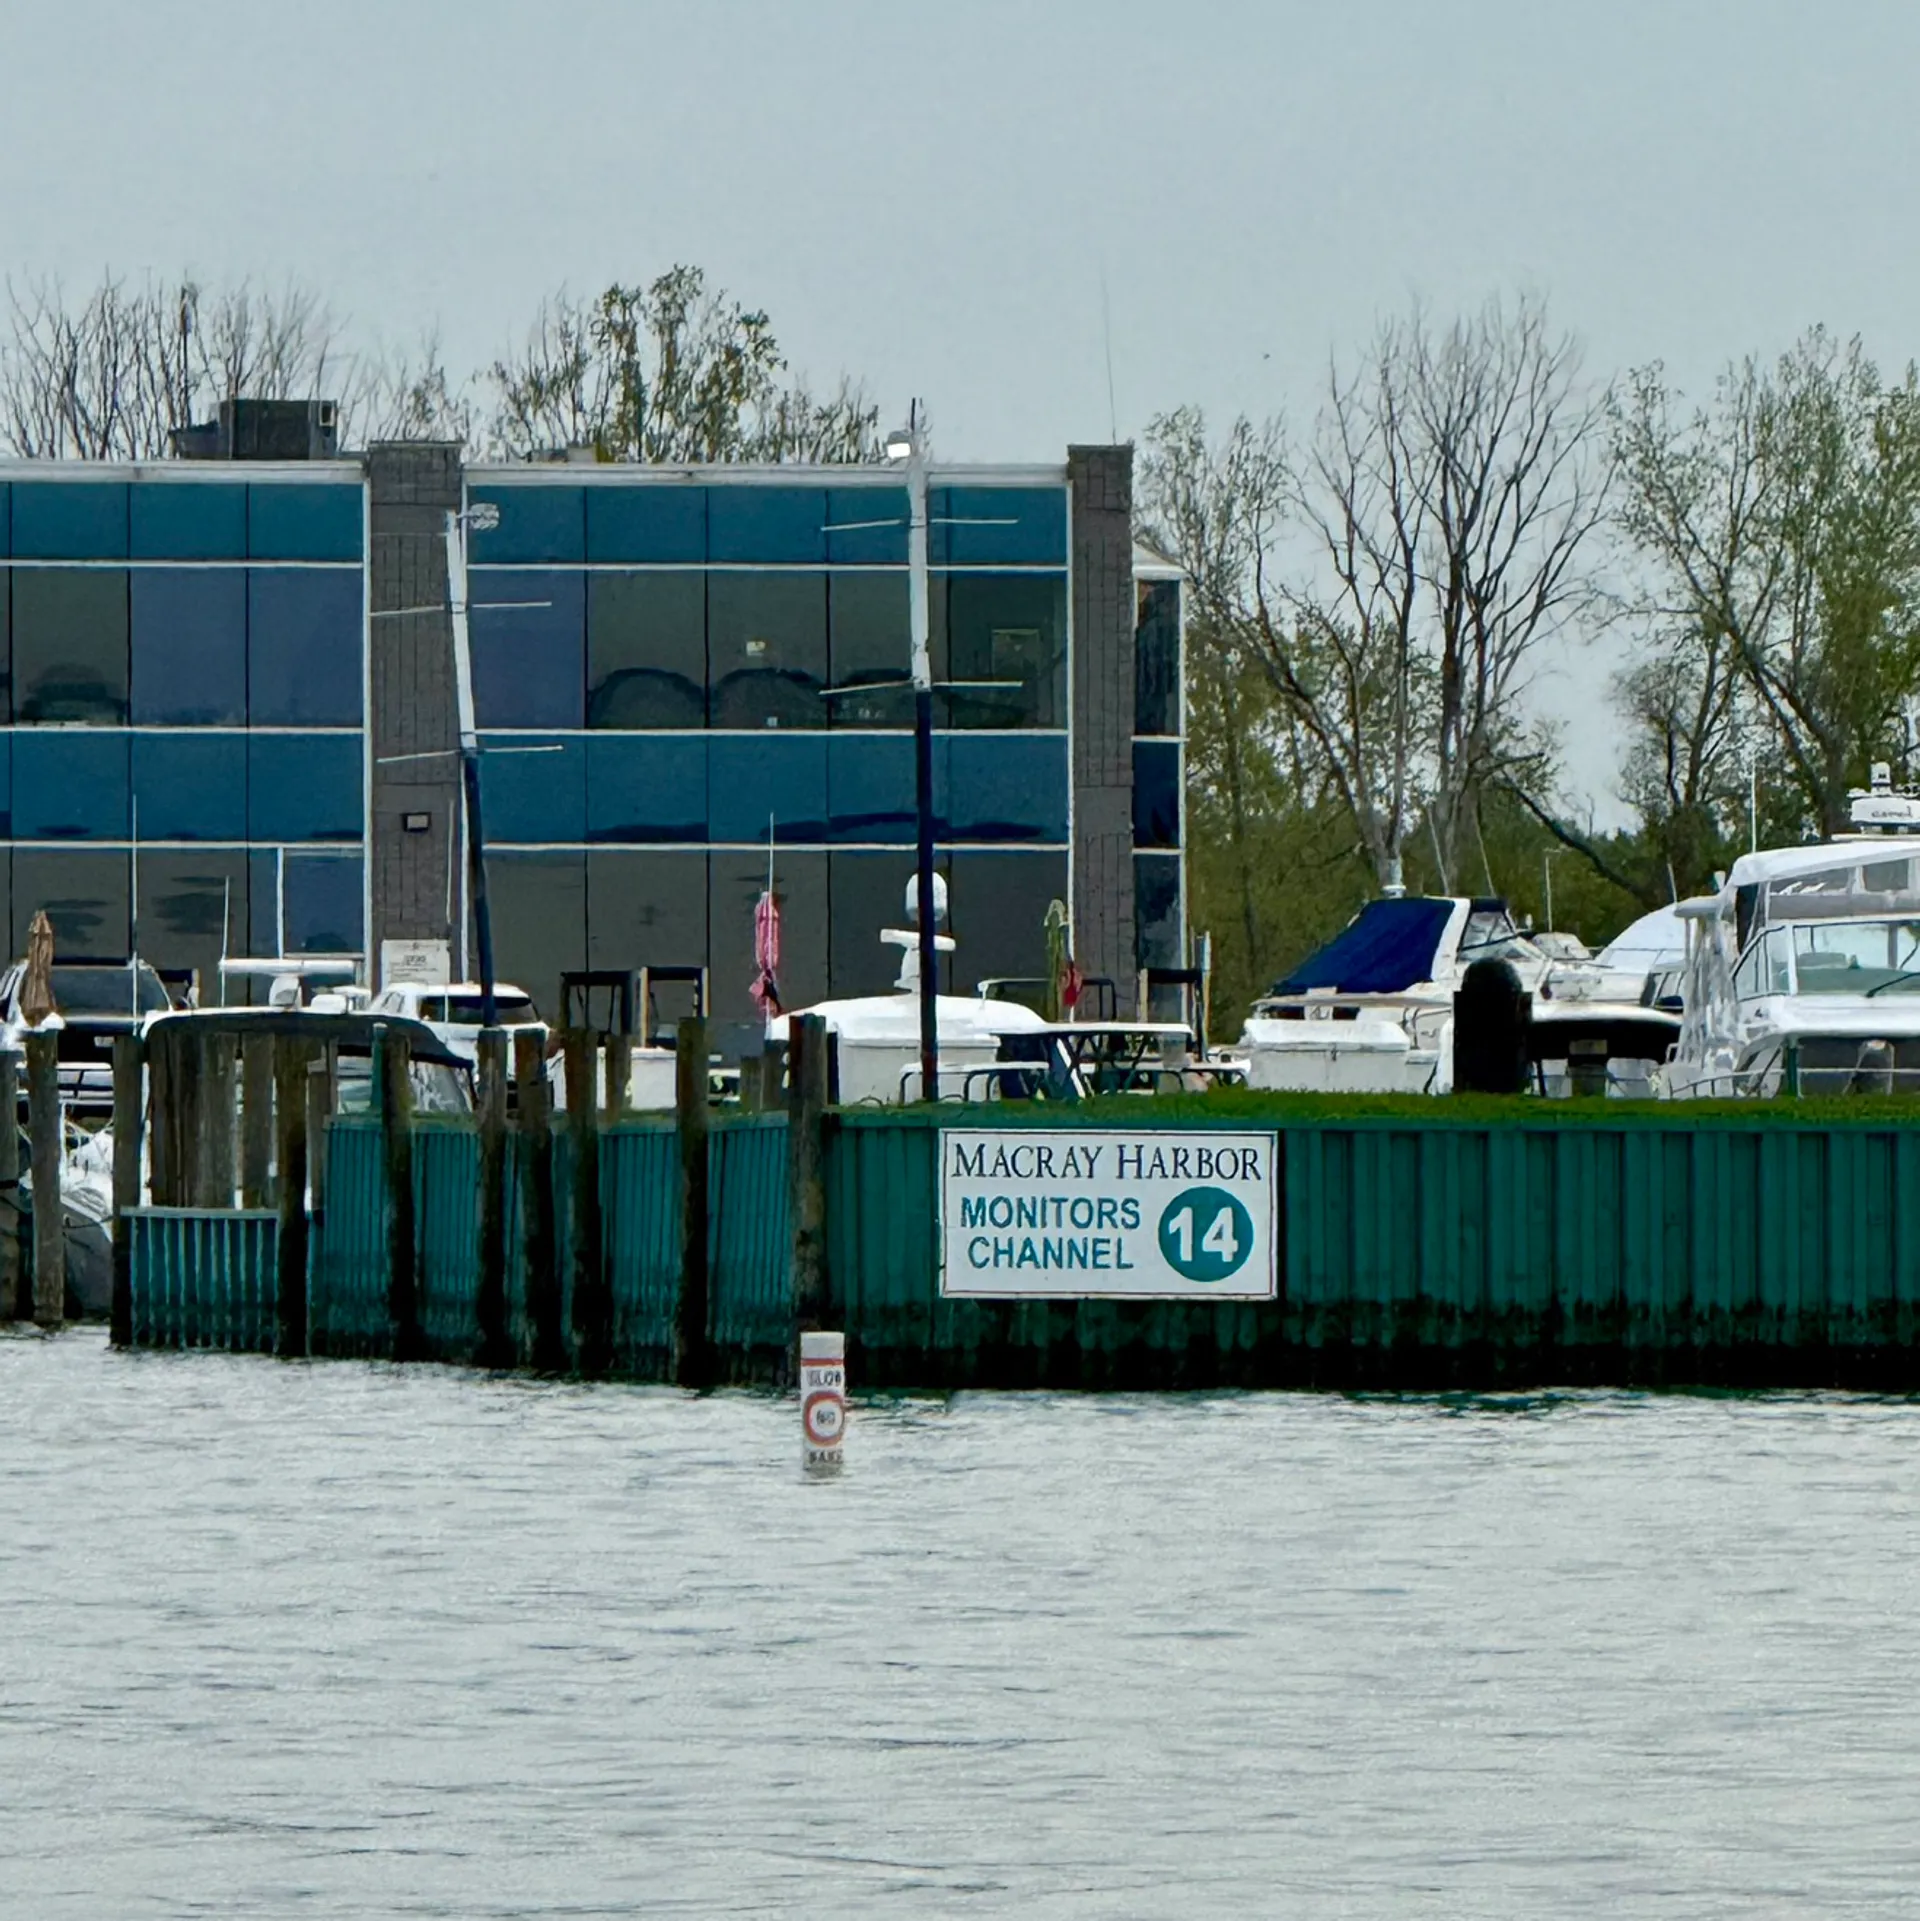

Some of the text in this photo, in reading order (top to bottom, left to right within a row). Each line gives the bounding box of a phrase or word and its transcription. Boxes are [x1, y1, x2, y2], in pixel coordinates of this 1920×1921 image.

[951, 1143, 1262, 1181] MACRAY HARBOR
[960, 1195, 1141, 1230] MONITORS
[1168, 1206, 1239, 1263] 14
[967, 1236, 1135, 1270] CHANNEL
